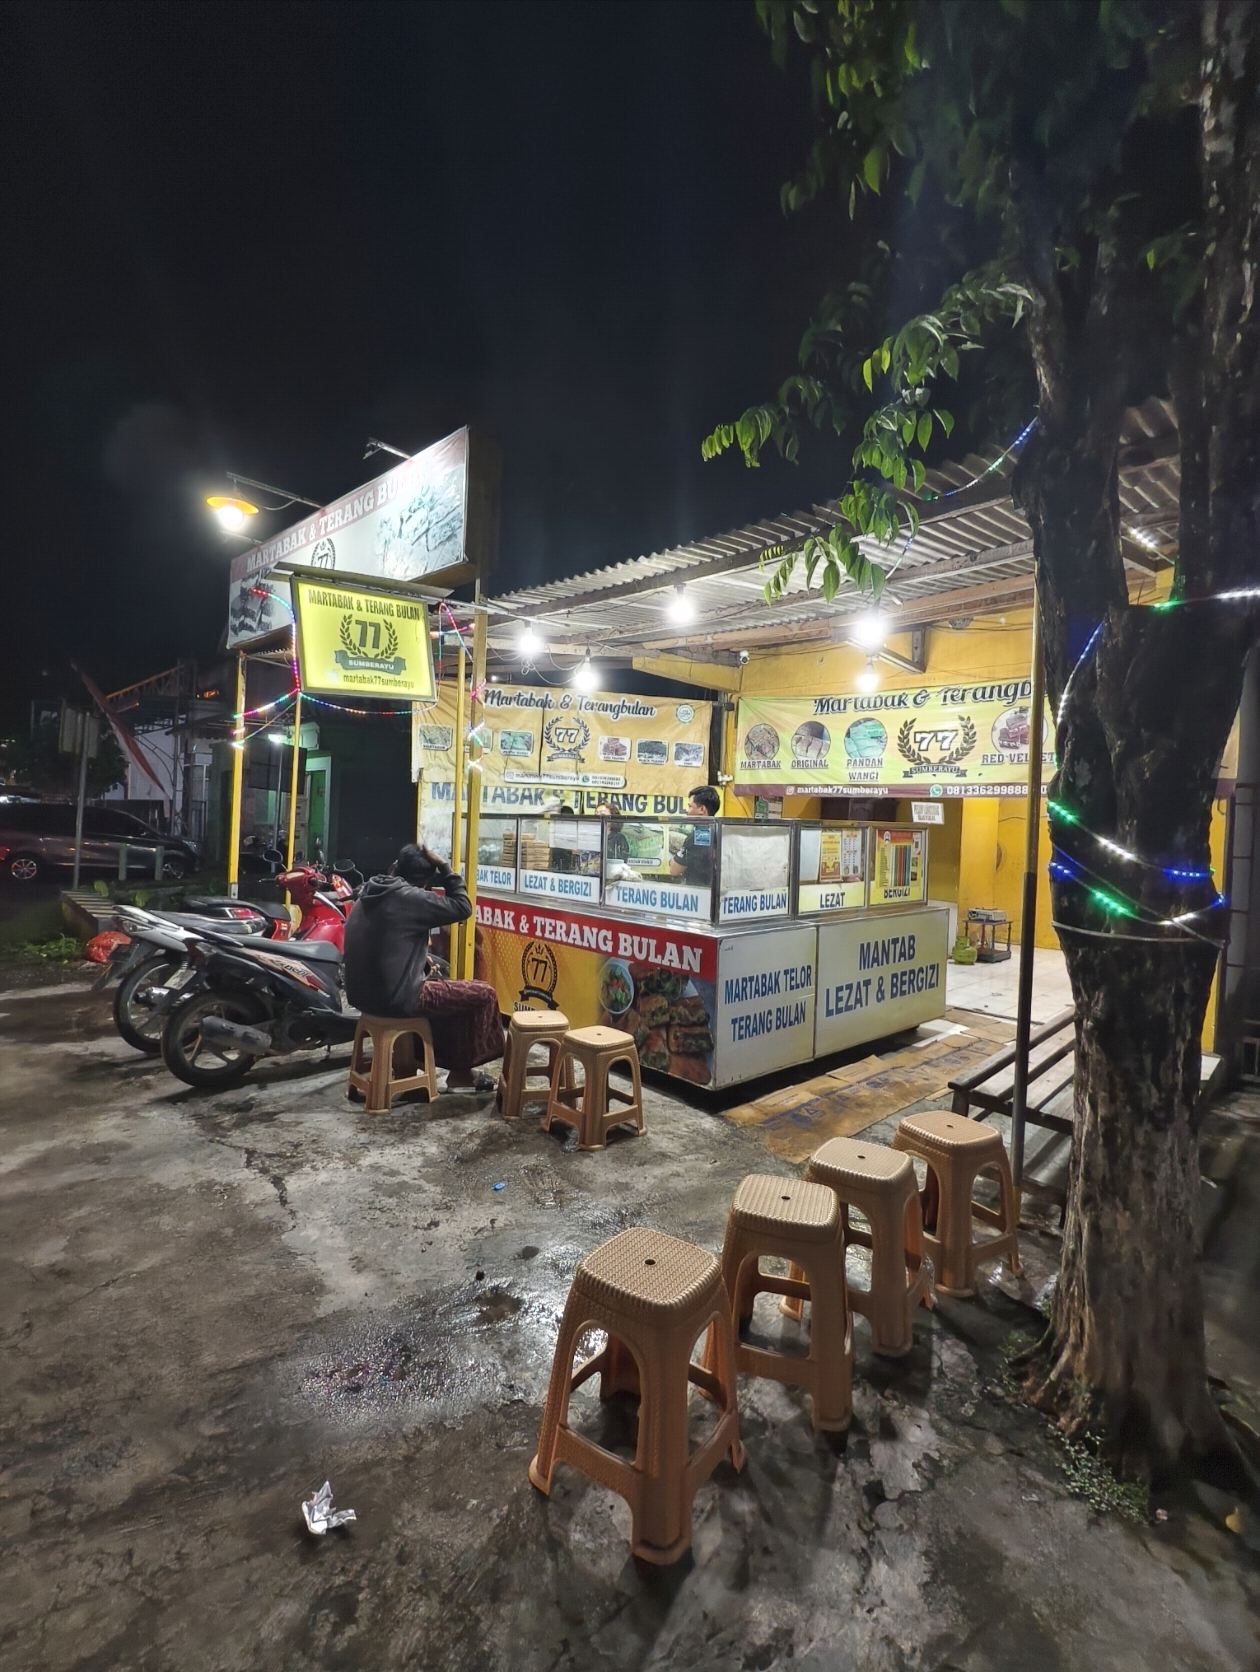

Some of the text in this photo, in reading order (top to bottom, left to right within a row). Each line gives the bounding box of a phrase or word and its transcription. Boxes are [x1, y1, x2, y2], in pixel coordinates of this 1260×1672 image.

[246, 529, 307, 572] MARTABAK
[309, 523, 317, 539] &
[319, 490, 375, 536] TERANG
[308, 589, 420, 620] MARTABAK & TERANG BULAN
[355, 619, 381, 649] 77
[348, 659, 394, 670] SUMBERAYU
[343, 673, 415, 690] martabak77sumberayu
[483, 688, 556, 710] Martabak
[560, 694, 572, 709] &
[577, 694, 657, 719] Terangbulan
[812, 692, 909, 715] Martabak
[913, 689, 930, 708] &
[555, 728, 579, 743] 77
[914, 730, 958, 751] 77
[740, 760, 782, 769] MARTABAK
[791, 759, 829, 769] ORIGINAL
[846, 758, 883, 768] PANDAN
[911, 764, 959, 774] SUMBERAYU
[981, 752, 1055, 765] RED VELET
[848, 772, 879, 781] WANGI
[797, 785, 889, 795] martabak77sumberayu
[490, 871, 512, 886] TELOR
[524, 874, 592, 897] LEZAT & BERGIZI
[616, 886, 699, 912] TERANG BULAN
[723, 892, 787, 914] TERANG BULAN
[820, 892, 845, 908] LEZAT
[519, 914, 529, 934] &
[533, 915, 613, 952] TERANG
[618, 932, 703, 973] BULAN
[859, 934, 916, 971] MANTAB
[531, 957, 548, 983] 77
[724, 965, 812, 1005] MARTABAK TELOR
[825, 963, 940, 1018] LEZAT & BERGIZI
[731, 1001, 807, 1042] TERANG BULAN
